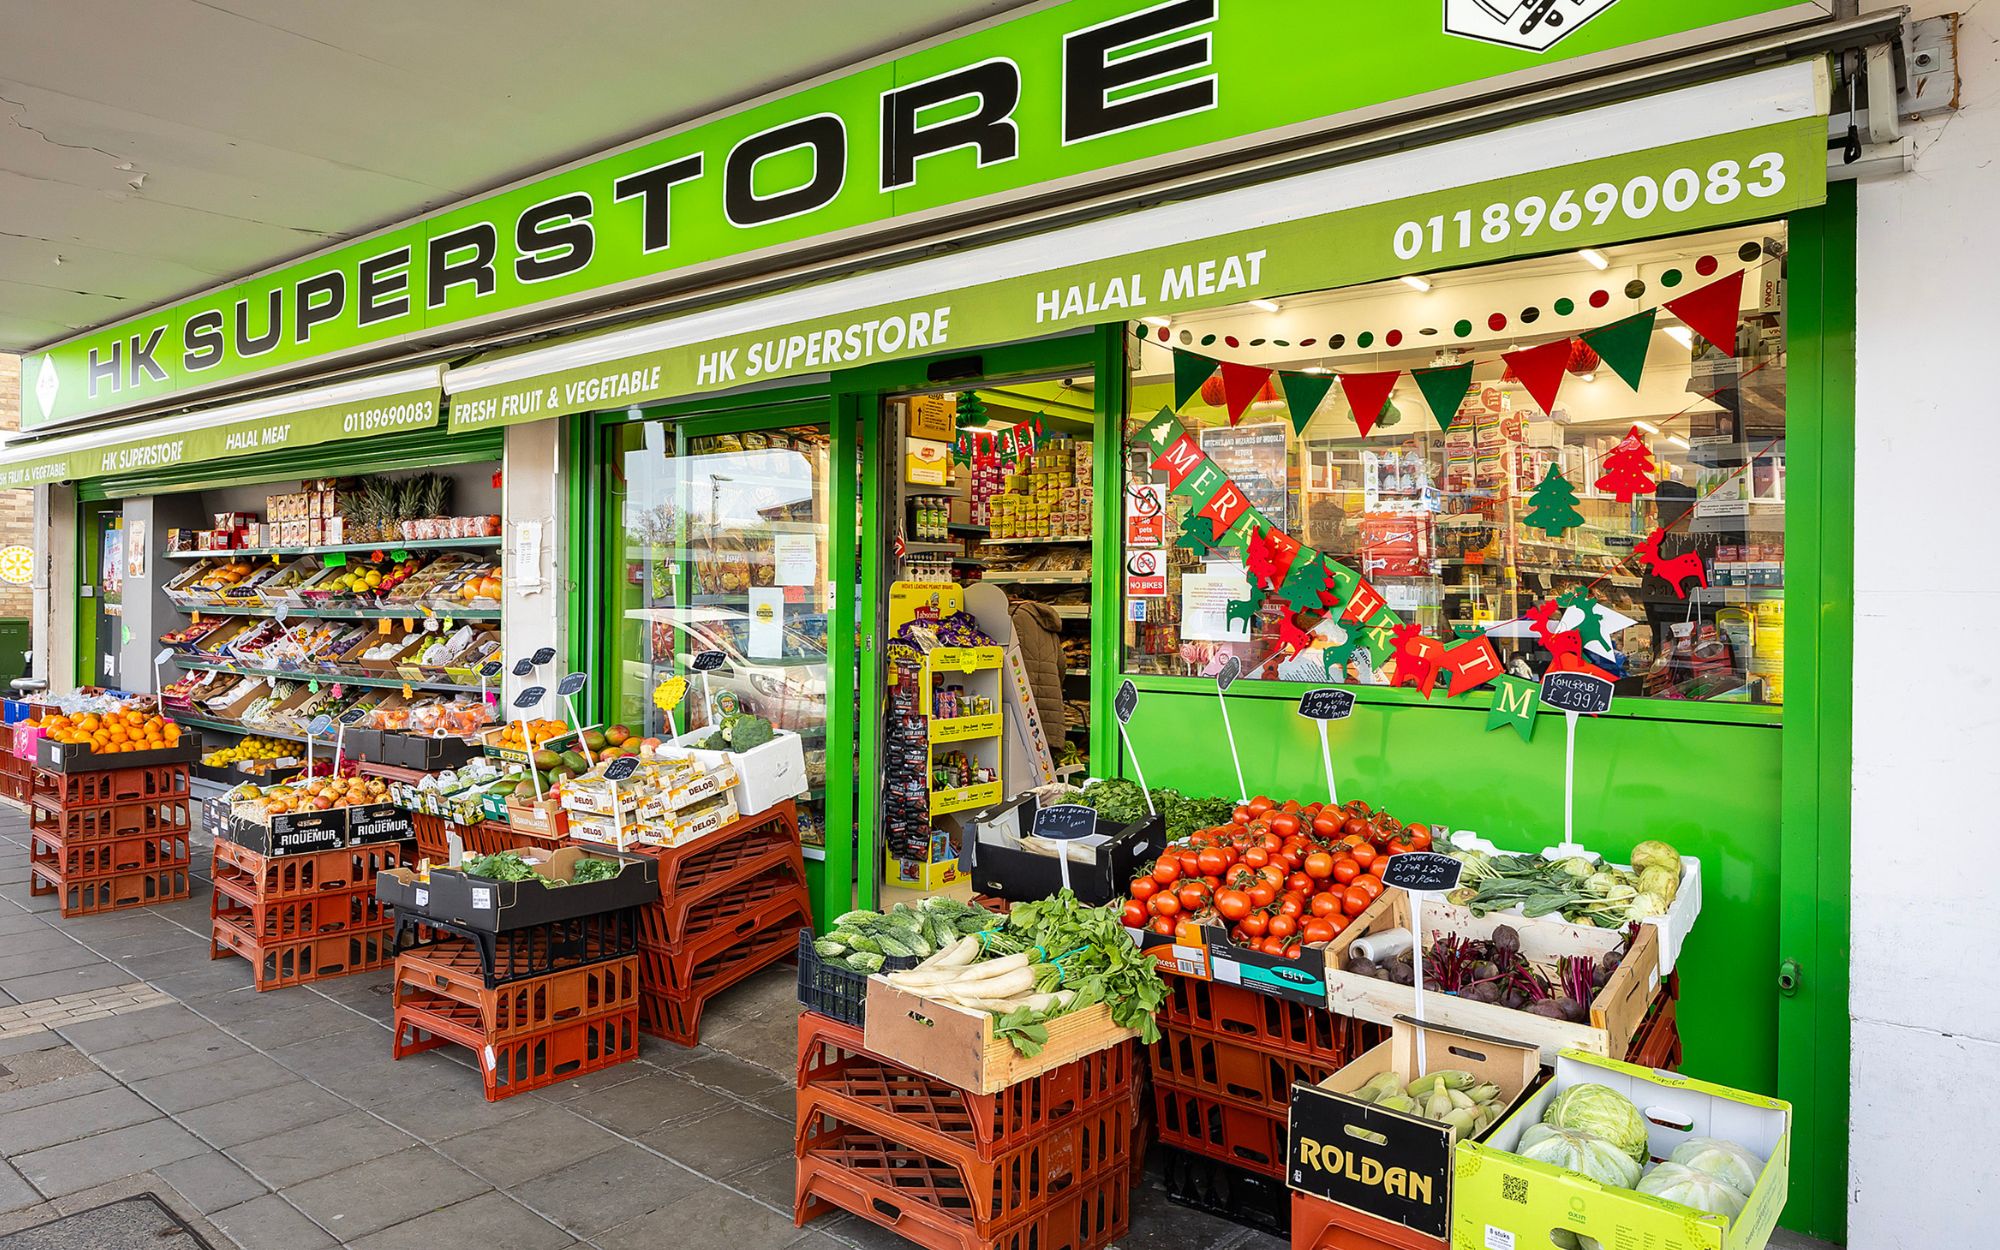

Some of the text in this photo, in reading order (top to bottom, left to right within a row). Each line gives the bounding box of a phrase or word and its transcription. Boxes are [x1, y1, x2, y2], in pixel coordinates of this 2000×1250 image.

[87, 0, 1219, 399] HK SUPERSTORE
[1392, 151, 1787, 261] 01189690083
[1034, 249, 1268, 324] HALAL MEAT
[1764, 280, 1773, 308] VINOD
[695, 306, 951, 386] HK SUPERSTORE
[454, 366, 661, 425] FRESH FRUIT & VEGETABLE
[343, 401, 433, 433] 01189690083
[225, 424, 292, 450] HALAL MEAT
[101, 440, 183, 472] HK SUPERSTORE
[8, 468, 24, 485] FRUIT
[25, 469, 30, 481] &
[31, 462, 66, 481] VEGETABLE
[1139, 526, 1153, 534] pets
[1130, 581, 1162, 589] NO BIKES
[689, 780, 714, 796] DELOS
[574, 796, 594, 806] DELOS
[646, 801, 662, 810] DELOS
[357, 820, 408, 836] RIQUEMUR
[582, 826, 603, 837] DELOS
[644, 830, 662, 838] DELOS
[692, 817, 717, 833] DELOS
[281, 829, 336, 846] RIQUEMUR
[1282, 969, 1305, 982] ESLY
[1300, 1136, 1433, 1206] ROLDAN
